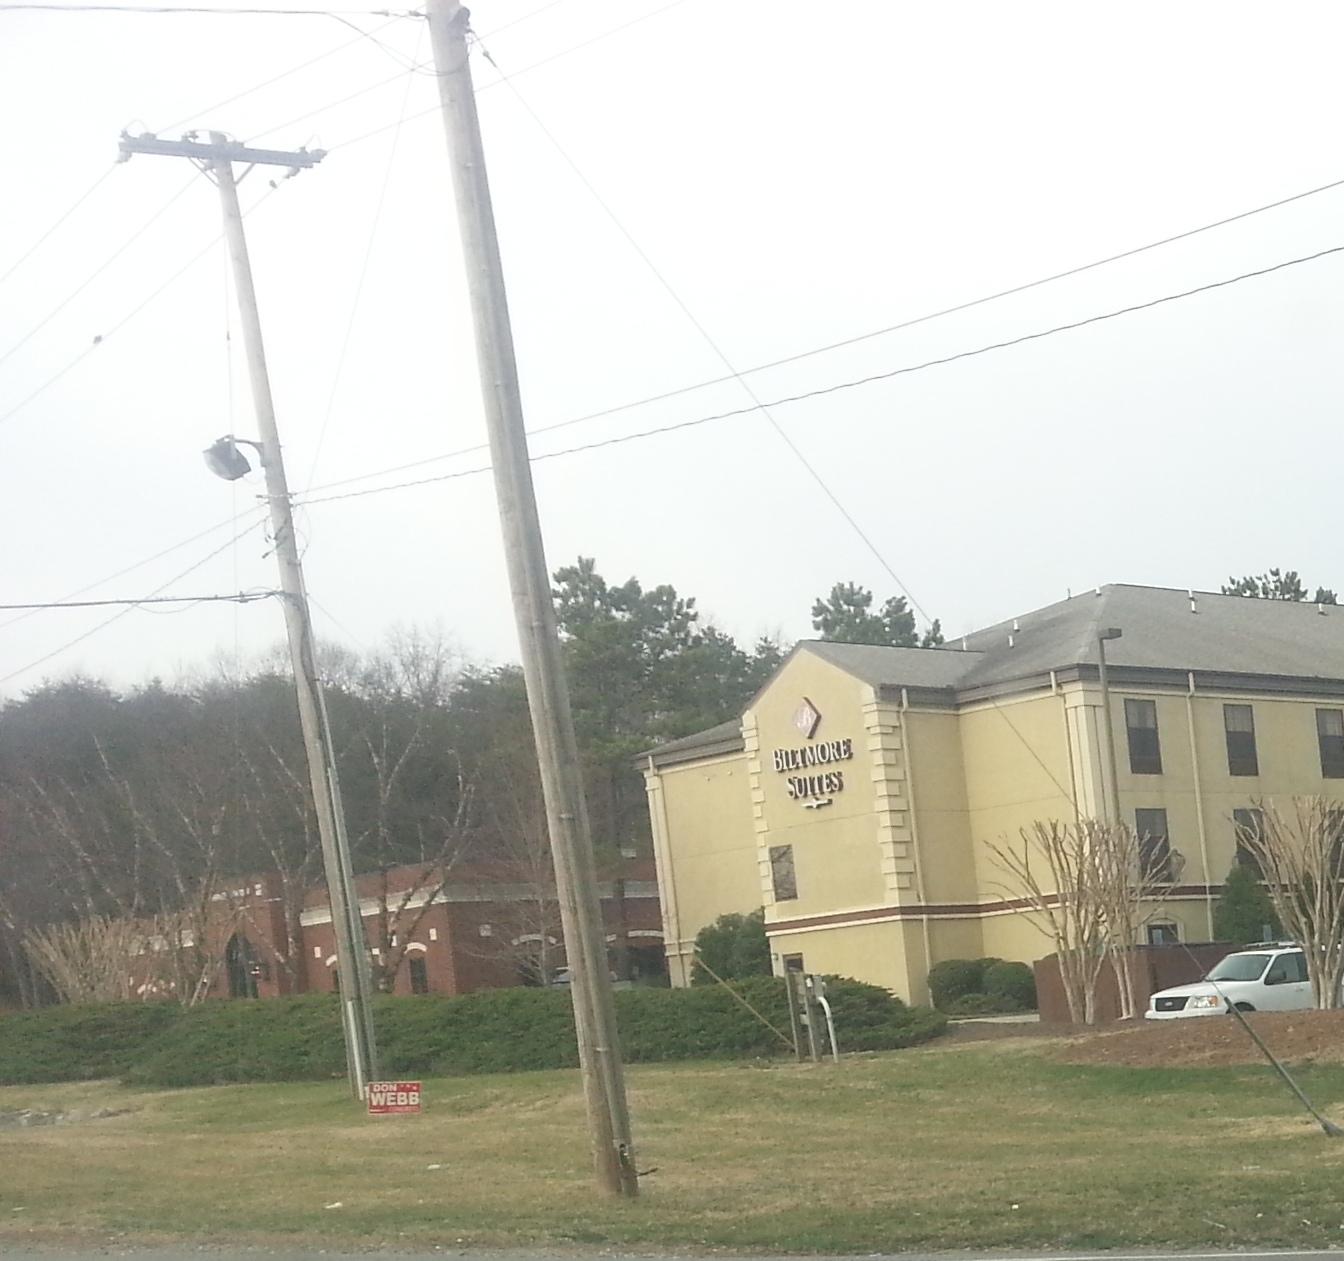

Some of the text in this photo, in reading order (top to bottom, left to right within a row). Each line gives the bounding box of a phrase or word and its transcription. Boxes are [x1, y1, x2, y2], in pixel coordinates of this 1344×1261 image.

[772, 738, 853, 772] BILTMORE
[787, 771, 843, 799] SUITES
[373, 1084, 397, 1092] DON
[371, 1092, 420, 1106] WEBB
